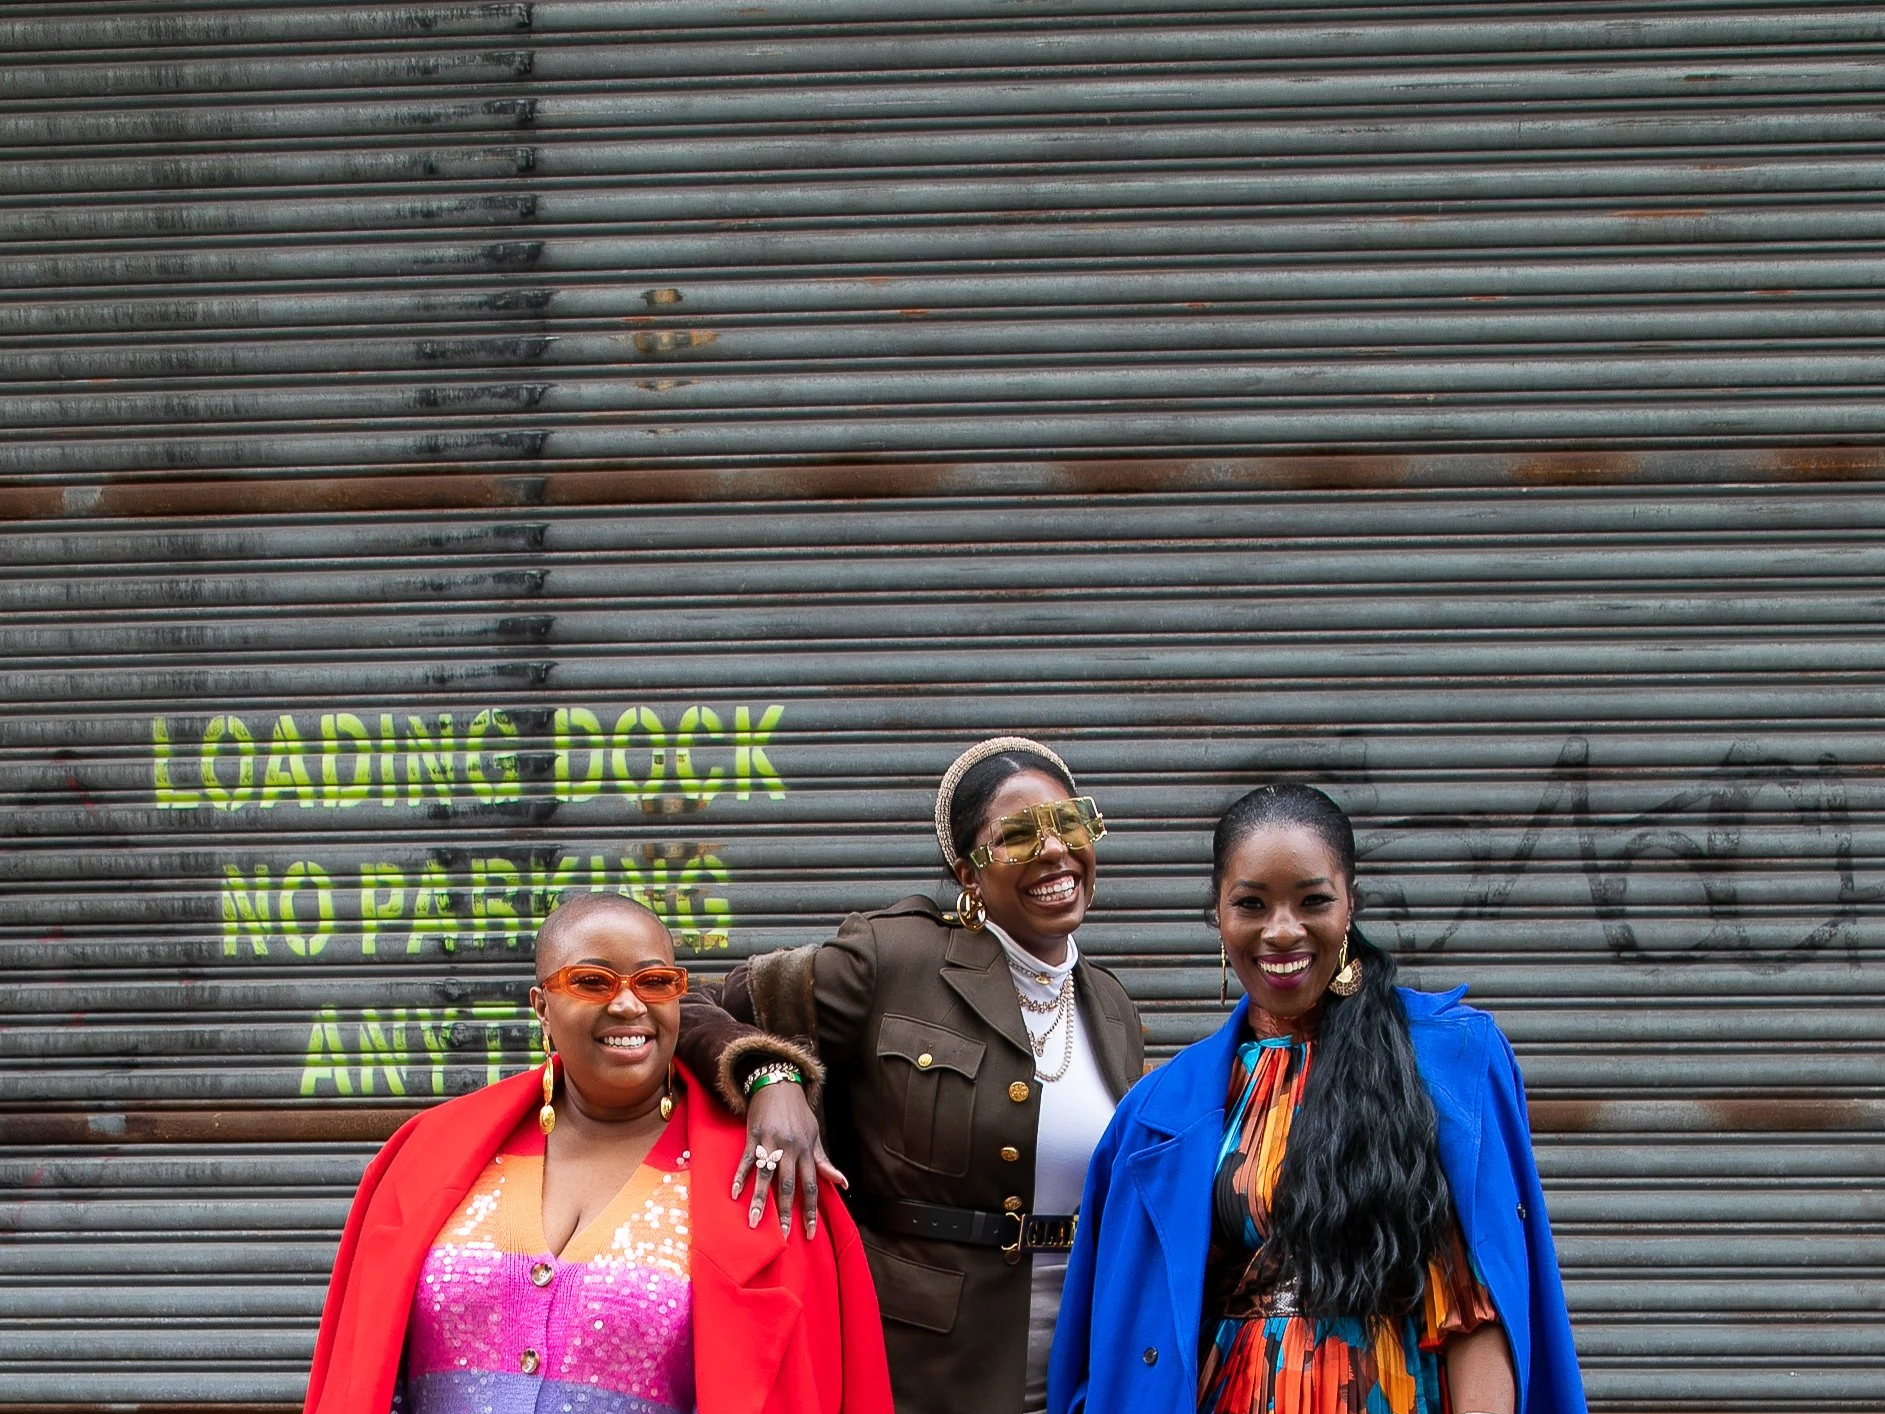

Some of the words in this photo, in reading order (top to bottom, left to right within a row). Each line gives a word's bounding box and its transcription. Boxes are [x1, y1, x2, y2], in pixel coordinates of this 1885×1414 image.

[151, 708, 522, 811] LOADING
[554, 705, 787, 802] DOCK
[222, 861, 335, 956] NO
